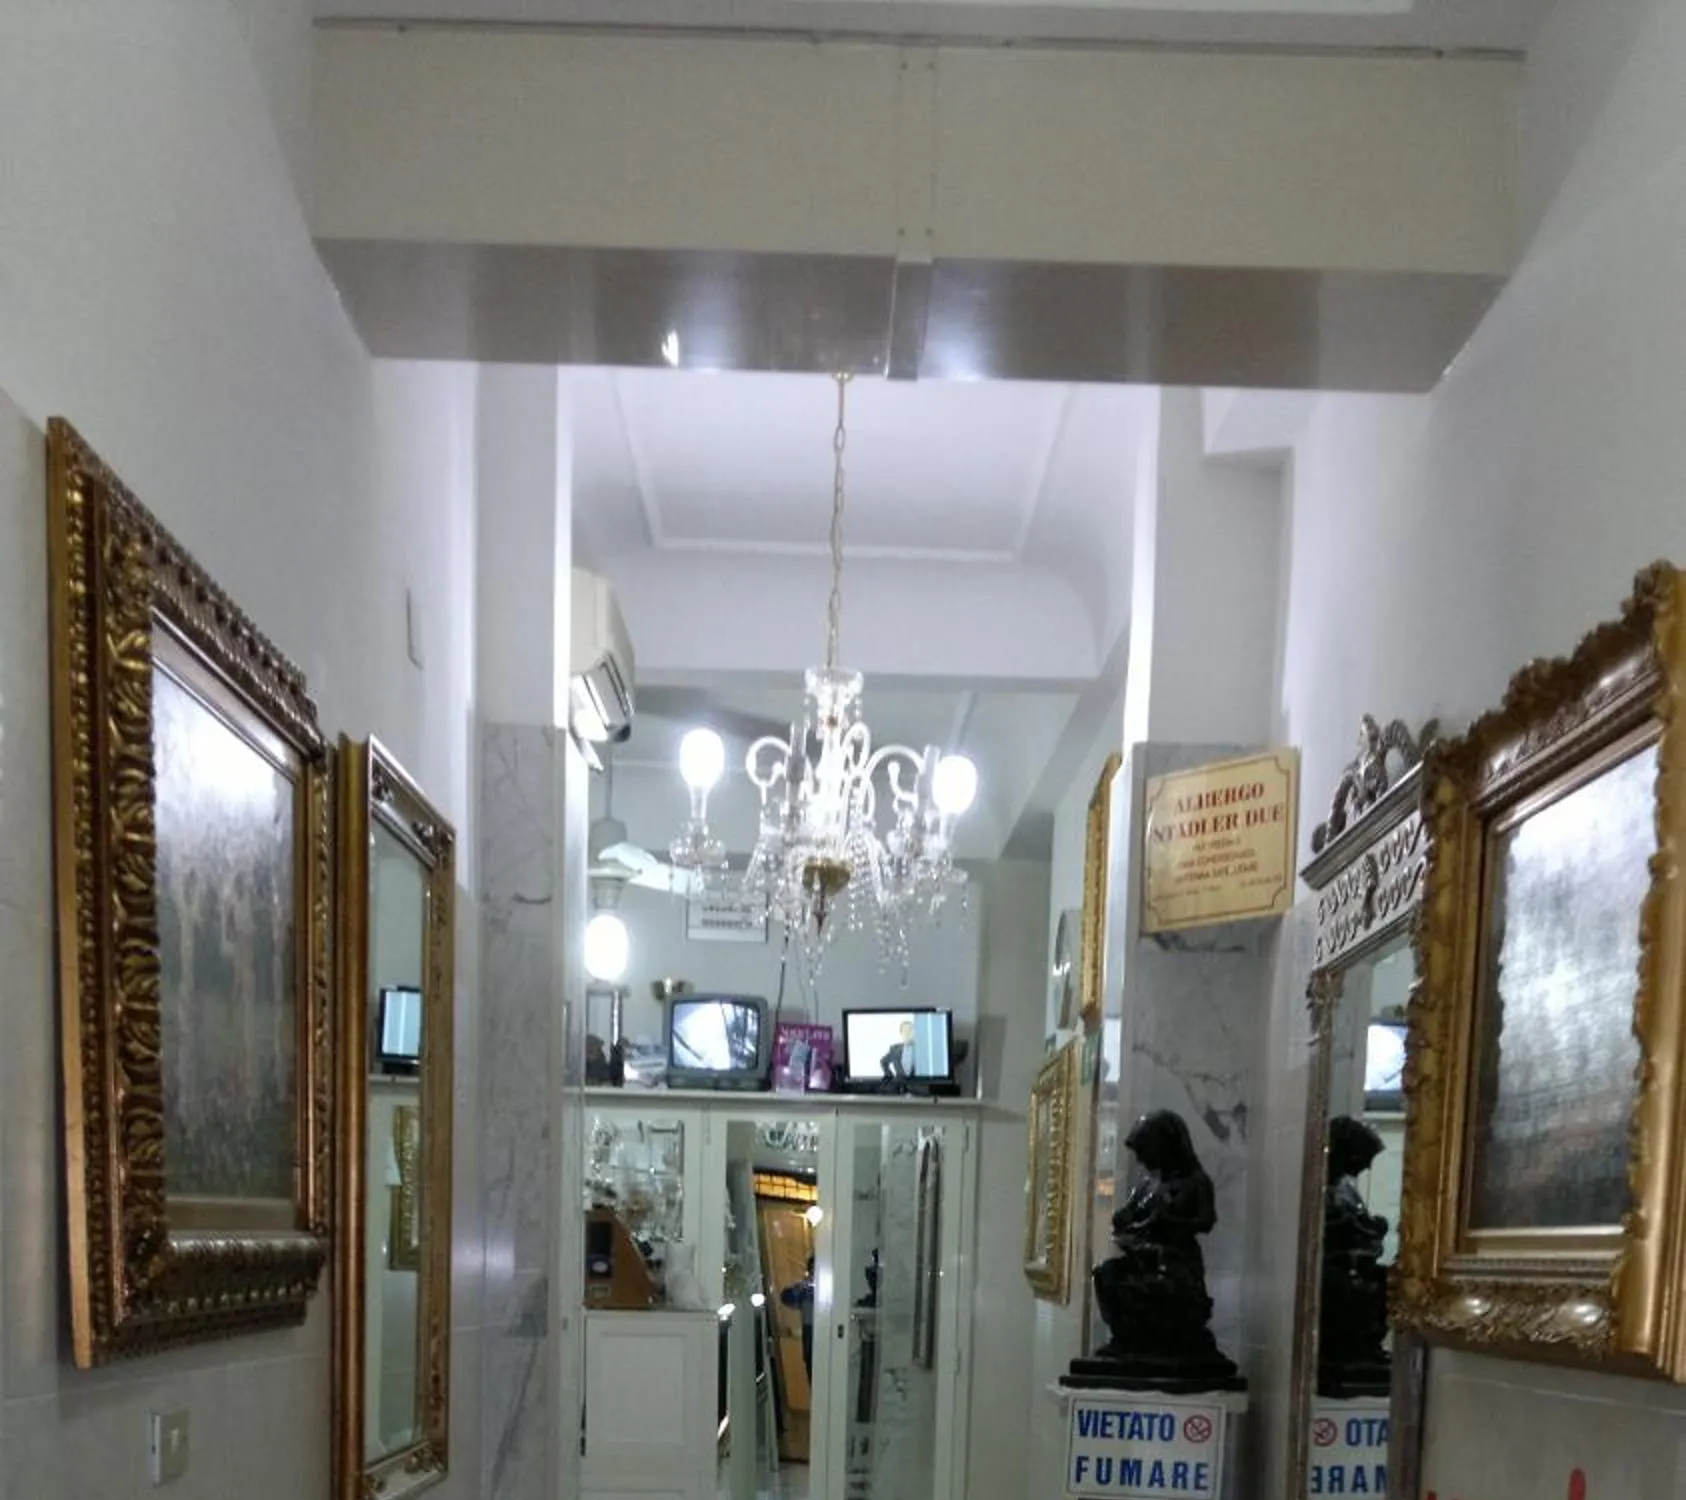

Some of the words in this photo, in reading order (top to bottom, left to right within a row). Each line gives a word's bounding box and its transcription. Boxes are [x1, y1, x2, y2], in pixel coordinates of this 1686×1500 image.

[1174, 782, 1264, 813] ALBERGO
[1244, 802, 1284, 827] DUE
[1077, 1409, 1176, 1442] VIETATO
[1074, 1455, 1210, 1491] FUMARE
